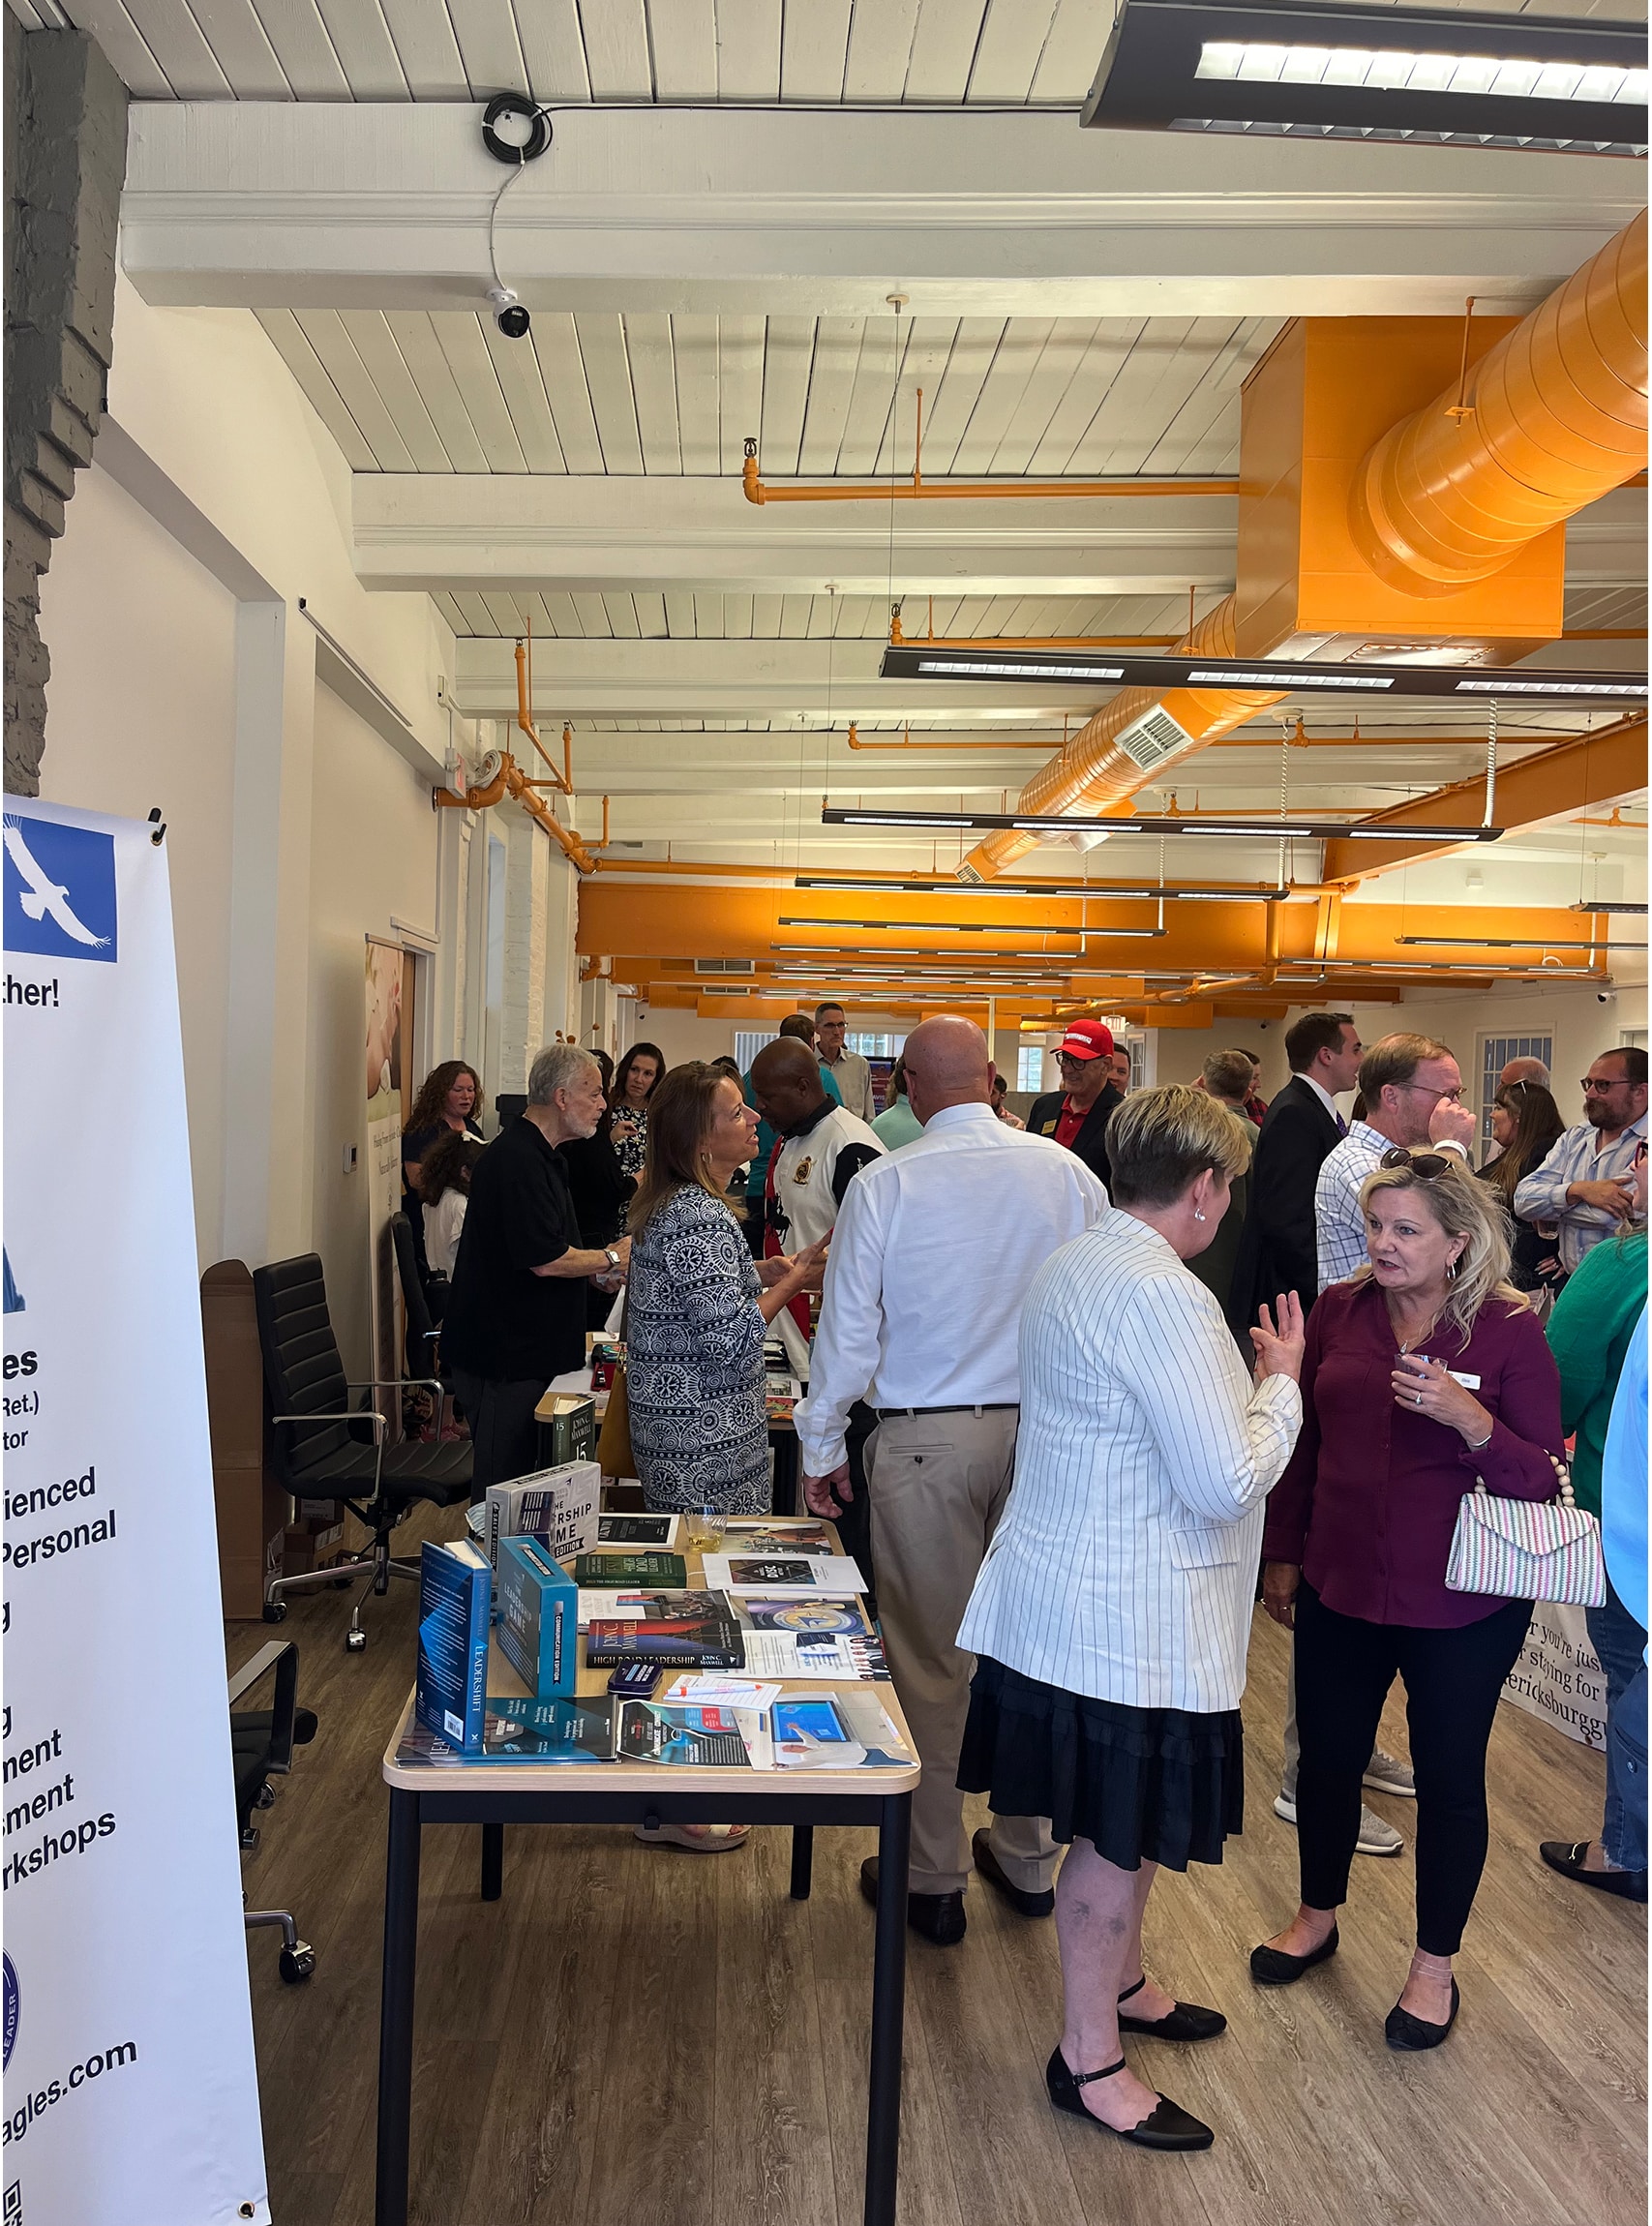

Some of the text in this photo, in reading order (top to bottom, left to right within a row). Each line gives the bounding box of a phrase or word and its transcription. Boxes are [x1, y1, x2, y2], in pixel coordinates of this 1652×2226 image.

[556, 1422, 564, 1431] 15
[4, 1466, 96, 1520] ienced
[555, 1500, 564, 1510] HE
[555, 1503, 592, 1525] RSHIP
[556, 1540, 581, 1557] EDITION
[621, 1620, 638, 1650] MAXWELL
[1540, 1625, 1573, 1659] you're
[1575, 1643, 1607, 1675] jus
[471, 1645, 484, 1713] LEADERSHIFT
[1530, 1649, 1572, 1694] staying
[1576, 1674, 1600, 1701] for
[1503, 1673, 1607, 1740] ericksburgg
